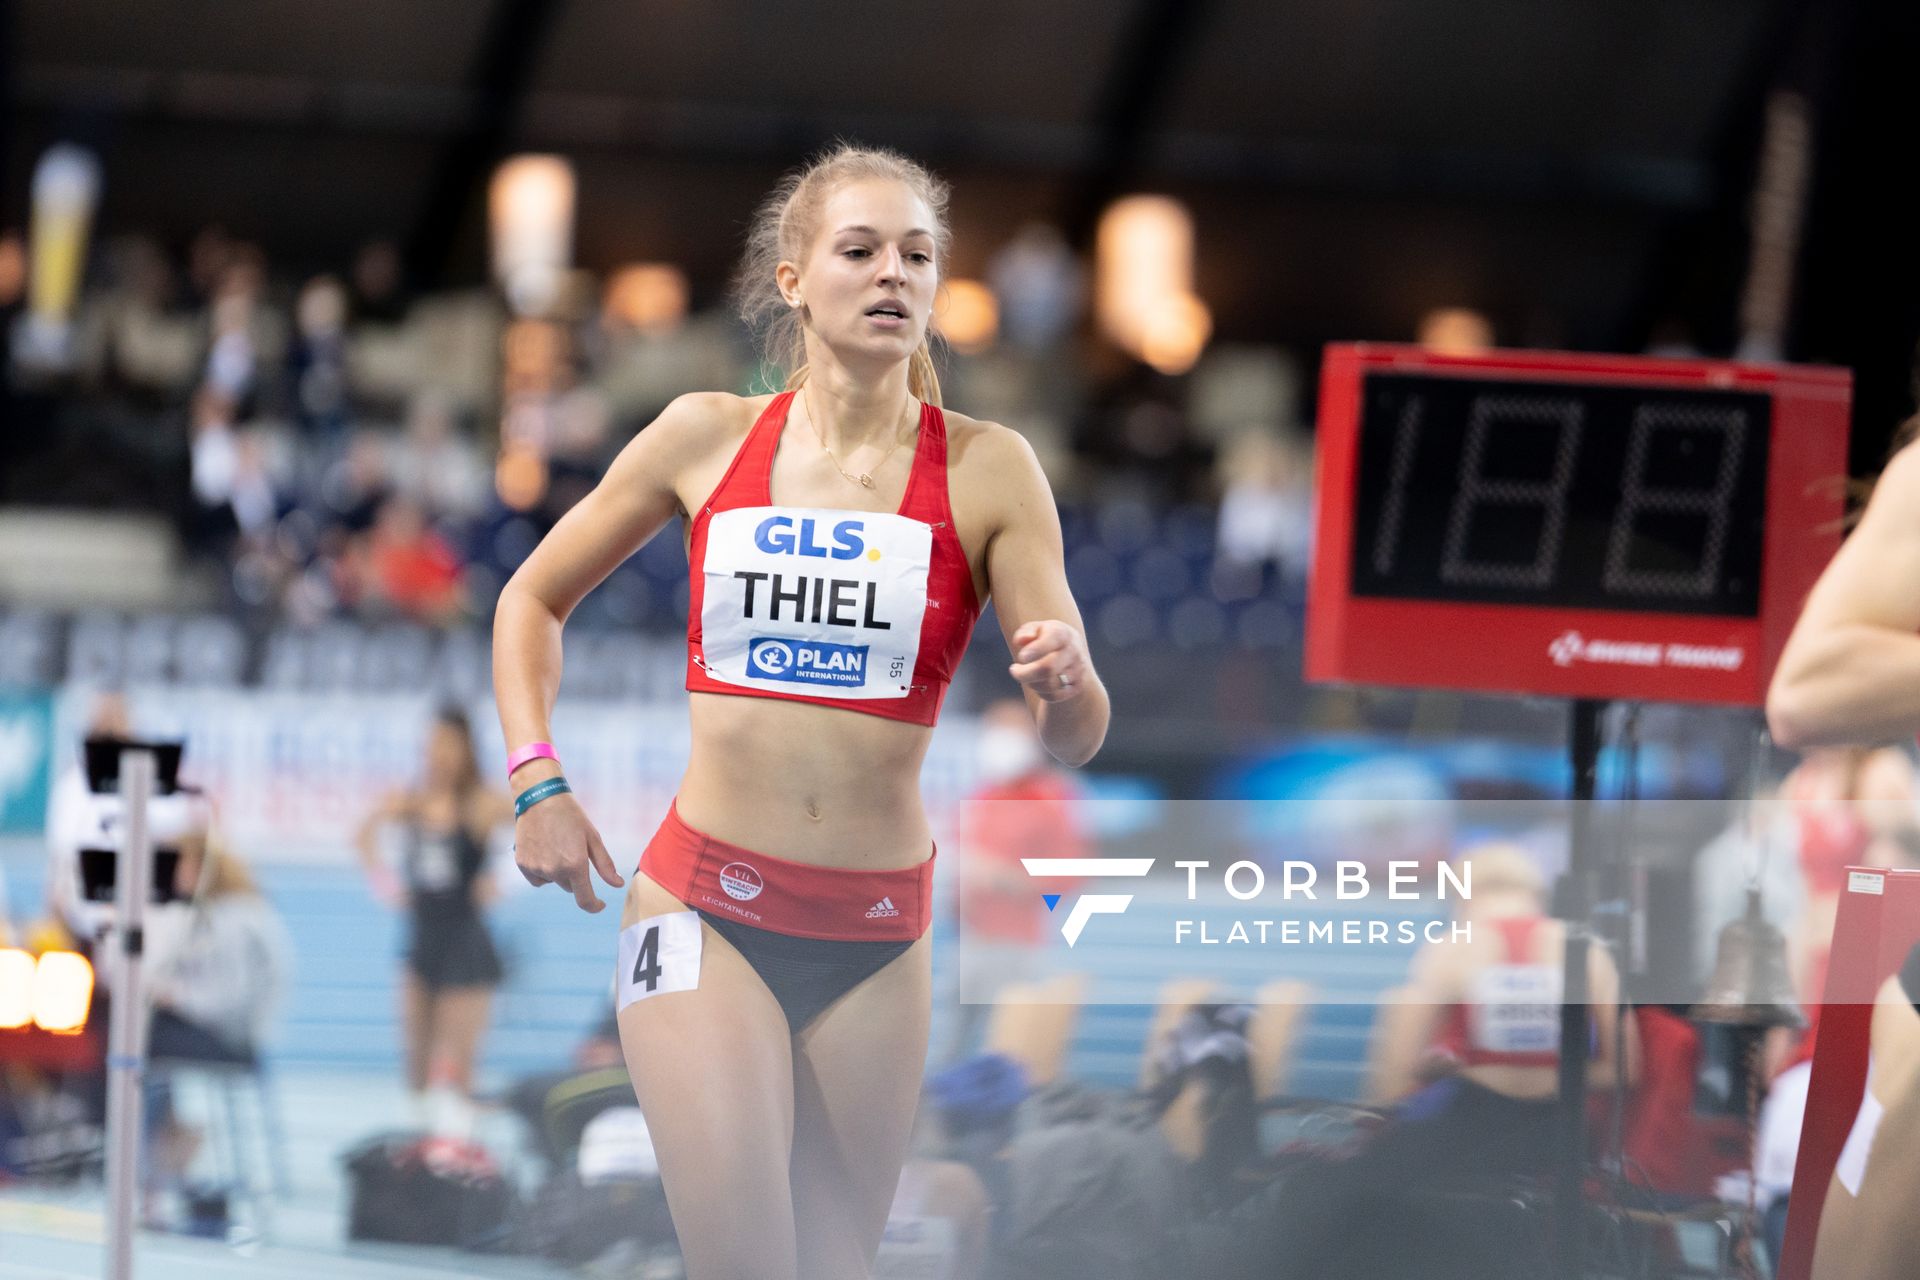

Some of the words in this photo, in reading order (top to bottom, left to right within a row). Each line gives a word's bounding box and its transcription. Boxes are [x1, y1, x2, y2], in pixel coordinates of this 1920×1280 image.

[734, 571, 891, 630] THIEL
[797, 648, 862, 671] PLAN
[889, 655, 905, 678] 155
[796, 670, 861, 682] INTERNATIONAL
[702, 895, 761, 922] LEICHTATHLETIK
[865, 909, 899, 919] adidas
[632, 926, 662, 992] 4
